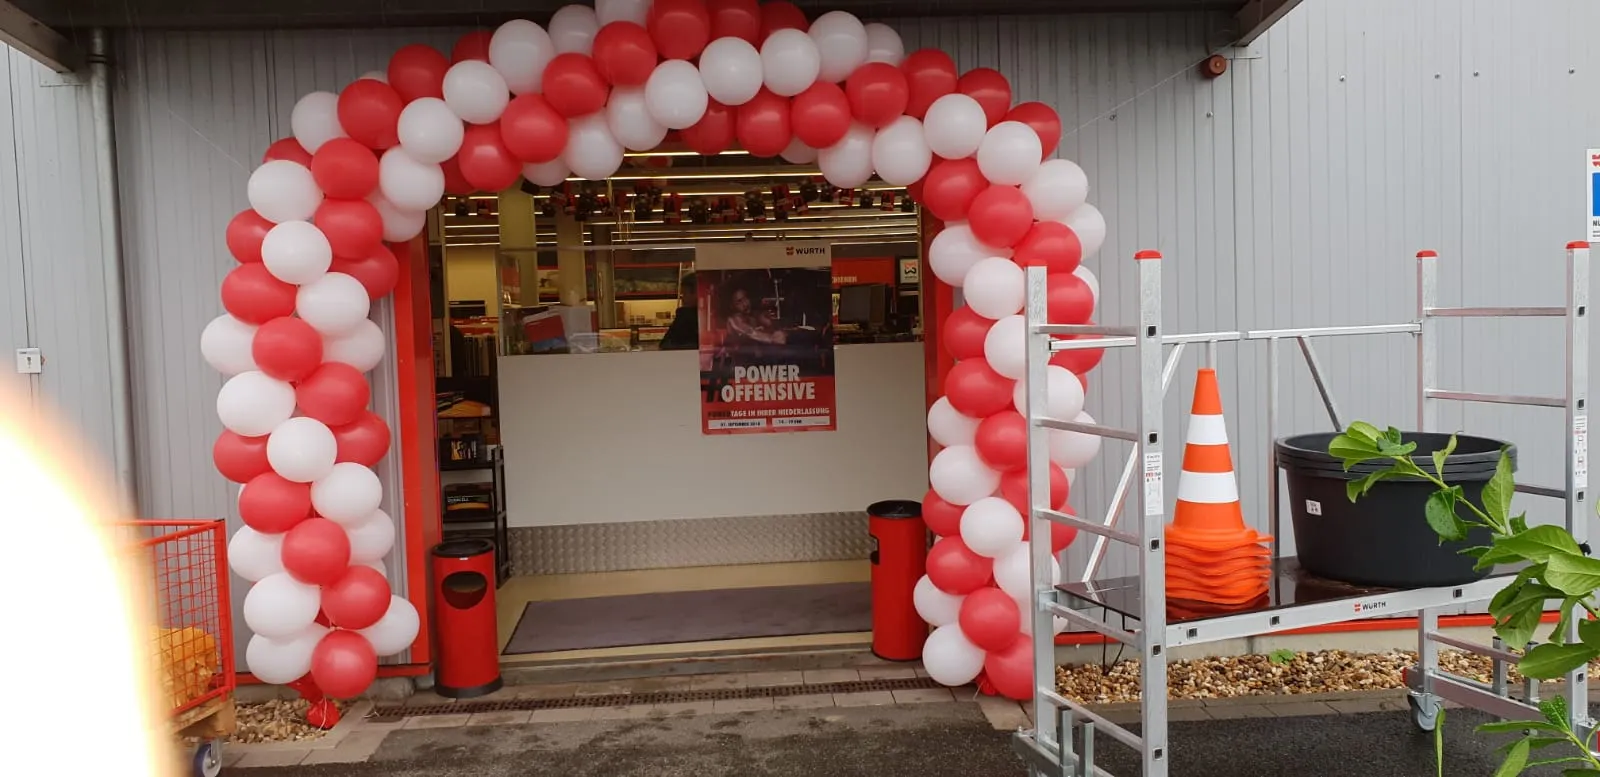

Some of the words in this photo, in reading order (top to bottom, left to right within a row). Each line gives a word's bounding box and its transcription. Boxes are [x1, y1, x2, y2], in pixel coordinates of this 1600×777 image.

[795, 246, 825, 255] WÜRTH
[734, 365, 800, 383] POWER
[721, 382, 816, 403] OFFENSIVE
[748, 409, 756, 417] IN
[757, 409, 777, 417] IHRER
[778, 407, 830, 416] NIEDERLASSUNG
